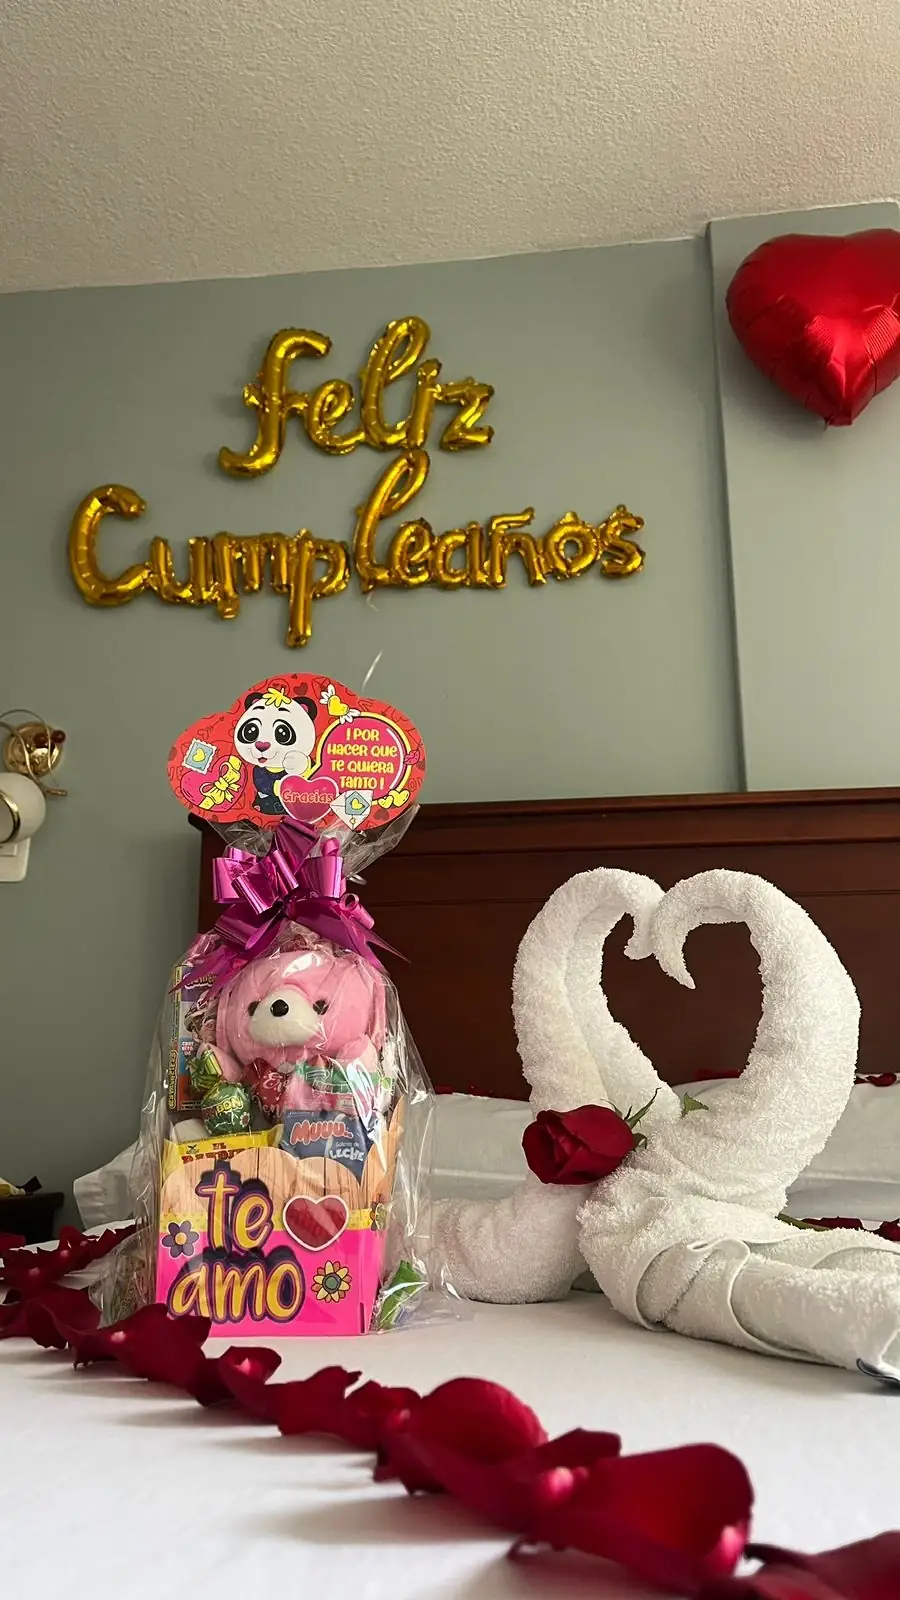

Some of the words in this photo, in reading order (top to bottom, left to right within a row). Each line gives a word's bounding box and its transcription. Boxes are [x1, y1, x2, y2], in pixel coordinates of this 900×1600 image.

[67, 448, 646, 648] Cumpleaños
[281, 788, 334, 804] Gracias
[197, 1170, 272, 1253] te
[168, 1259, 303, 1322] amo
